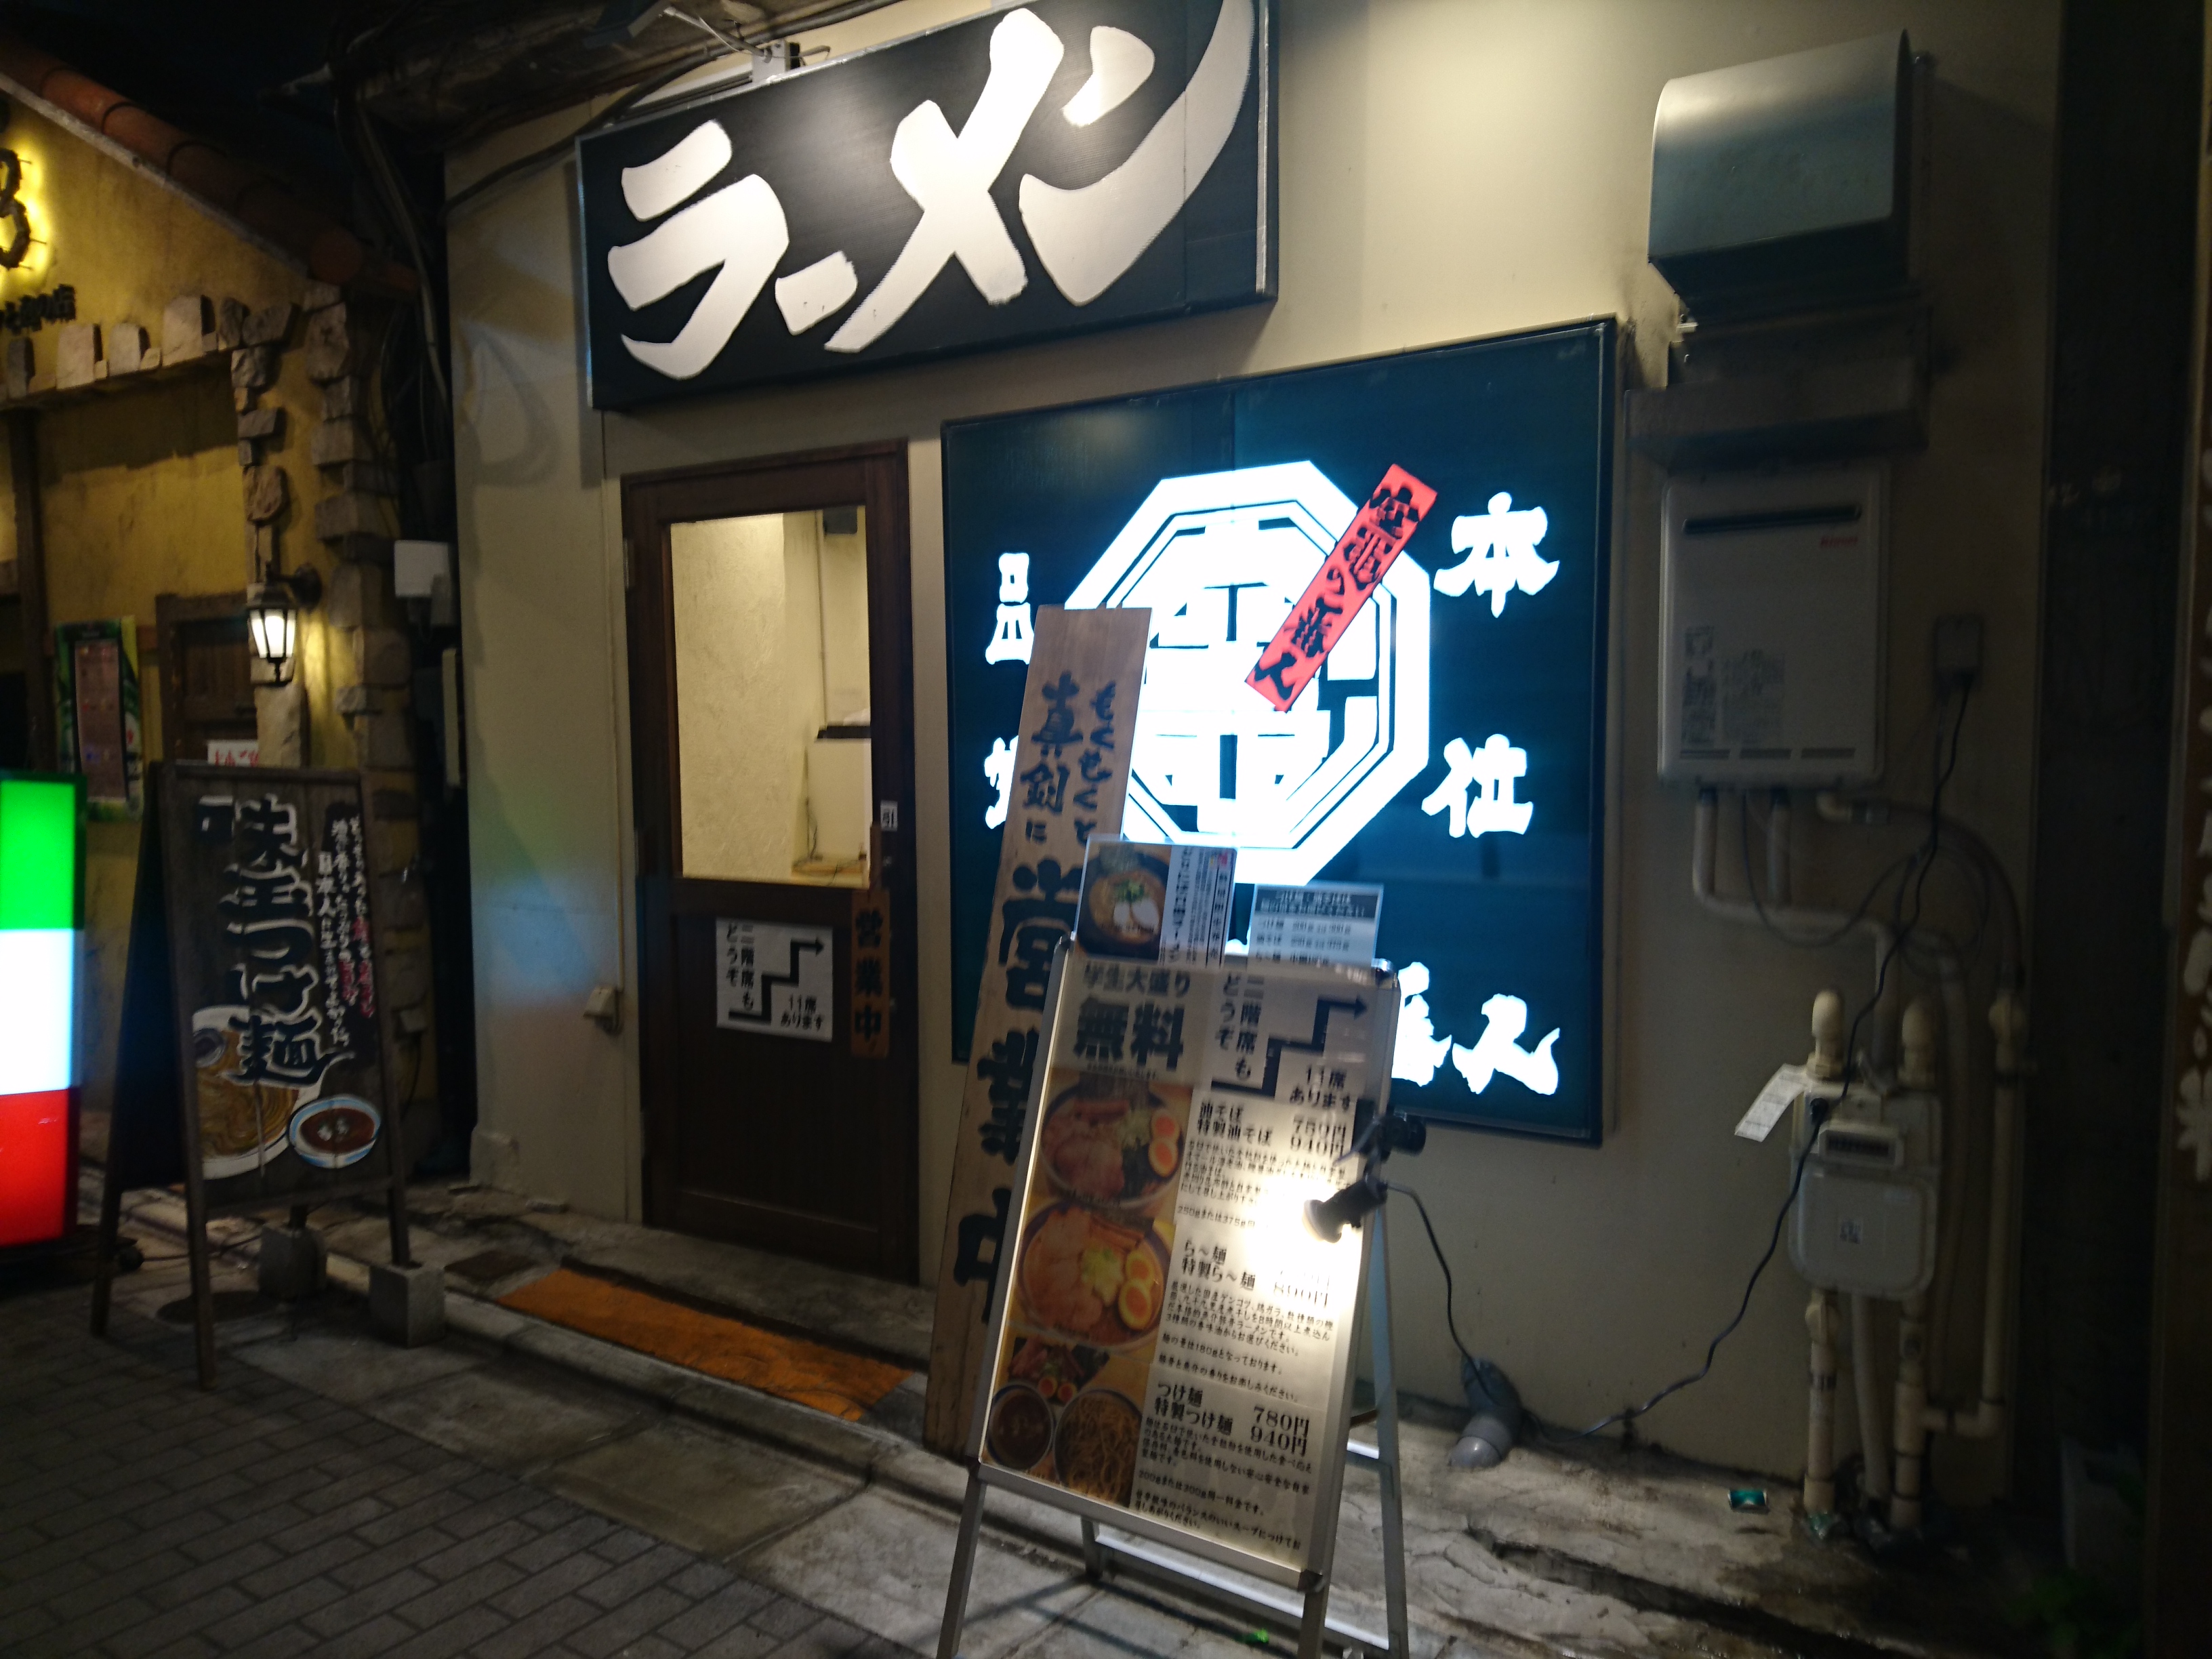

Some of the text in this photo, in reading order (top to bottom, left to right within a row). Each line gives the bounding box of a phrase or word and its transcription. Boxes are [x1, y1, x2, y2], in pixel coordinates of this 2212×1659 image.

[608, 0, 1254, 380] ラーメン
[1074, 996, 1185, 1072] 無料
[1154, 1397, 1307, 1456] 特製つけ麺 940円
[1158, 1383, 1309, 1437] つけ麺 780円
